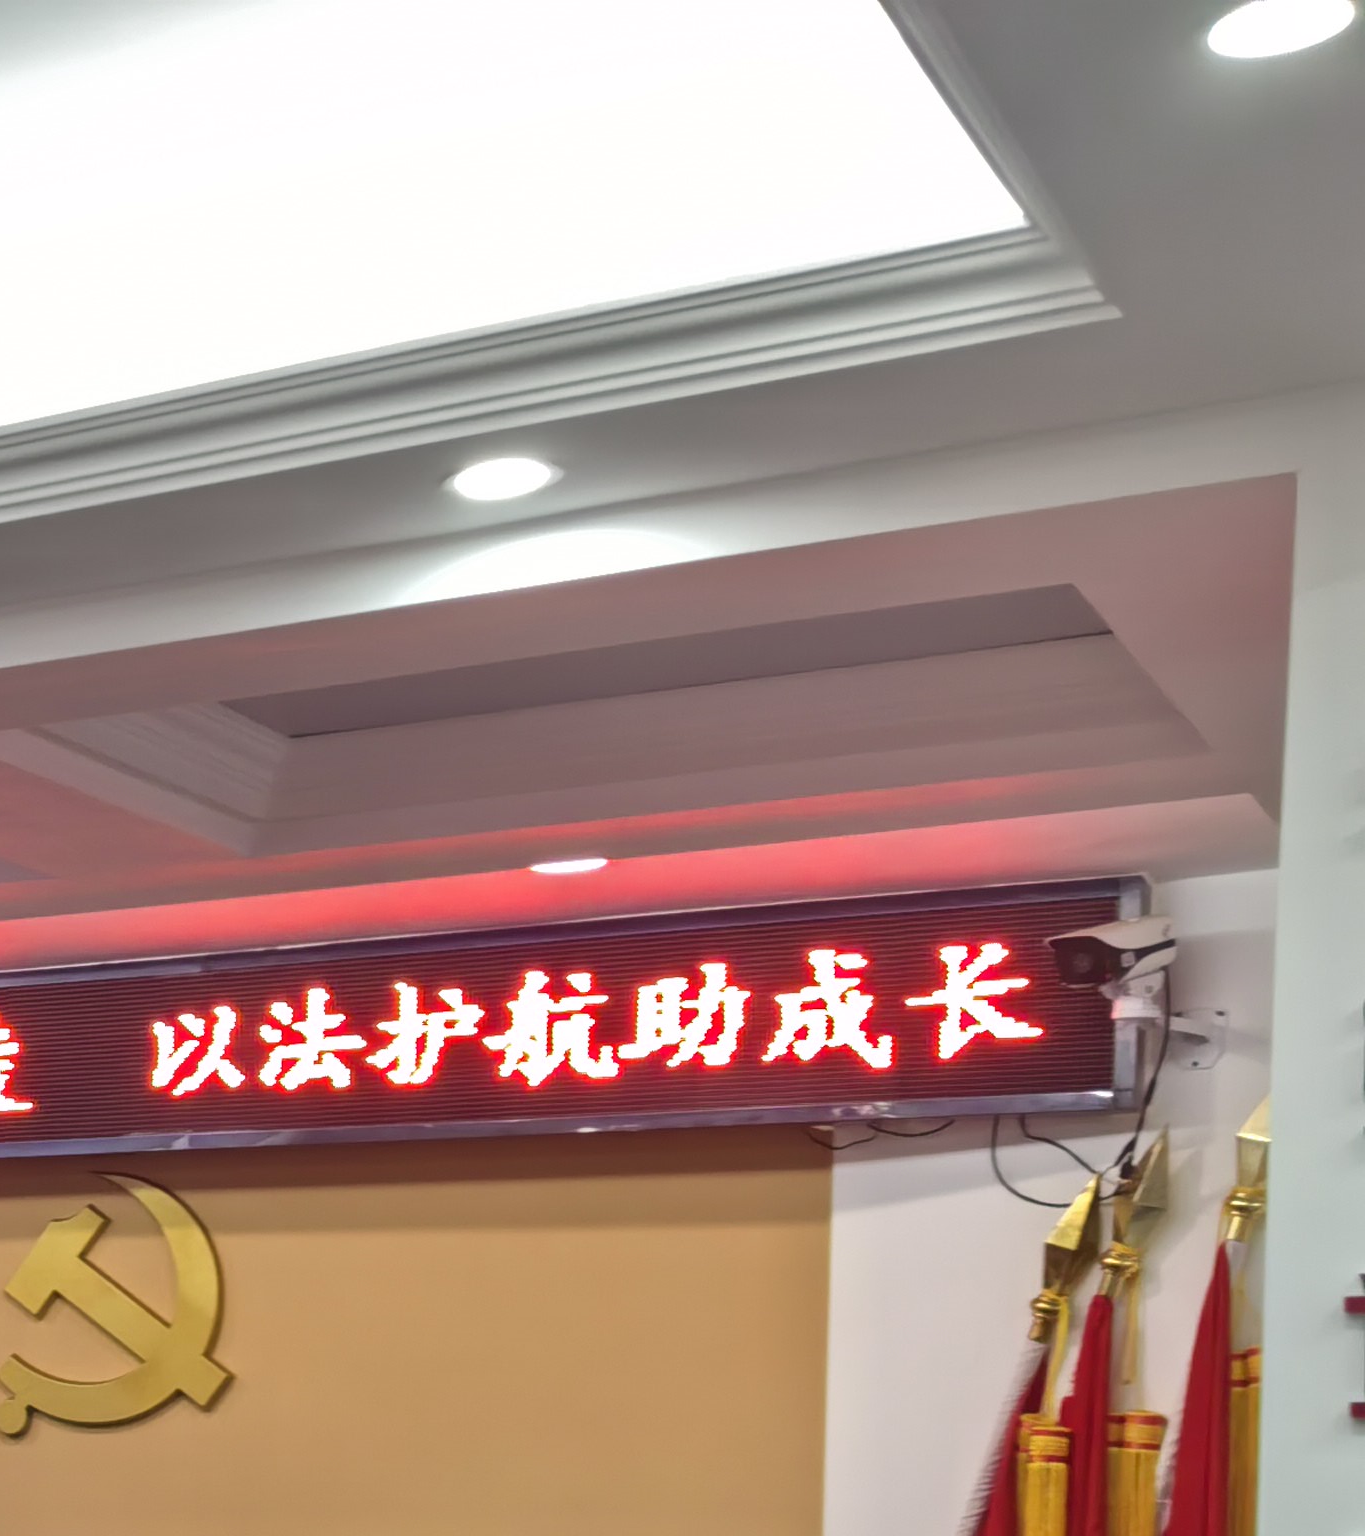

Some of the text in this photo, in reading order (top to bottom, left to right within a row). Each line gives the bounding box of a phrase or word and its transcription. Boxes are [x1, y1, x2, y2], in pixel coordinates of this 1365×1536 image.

[149, 941, 1044, 1097] 以法护航助成长
